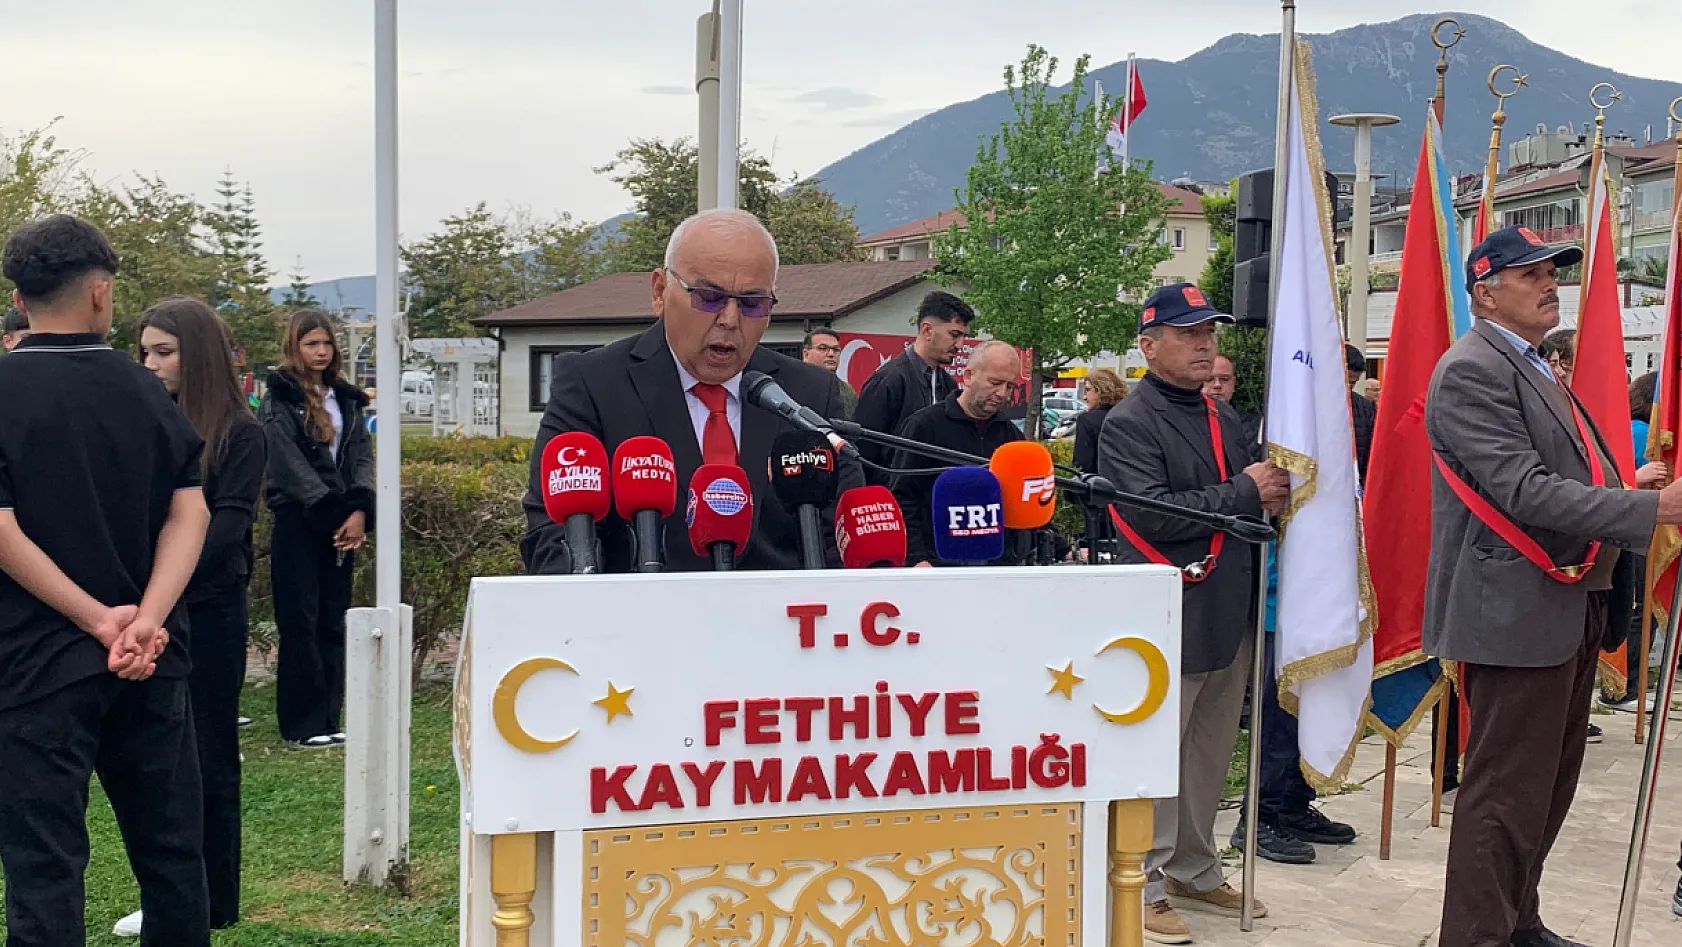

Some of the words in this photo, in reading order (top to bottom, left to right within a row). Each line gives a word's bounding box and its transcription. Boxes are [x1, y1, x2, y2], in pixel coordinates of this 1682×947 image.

[781, 451, 827, 466] Fethiye
[631, 468, 671, 482] MEDYA
[785, 466, 799, 475] TV
[856, 511, 895, 525] HABER
[947, 503, 1001, 529] FRT
[703, 680, 980, 747] FETHİYE
[590, 732, 1087, 814] KAYMAKAMLIĞI
